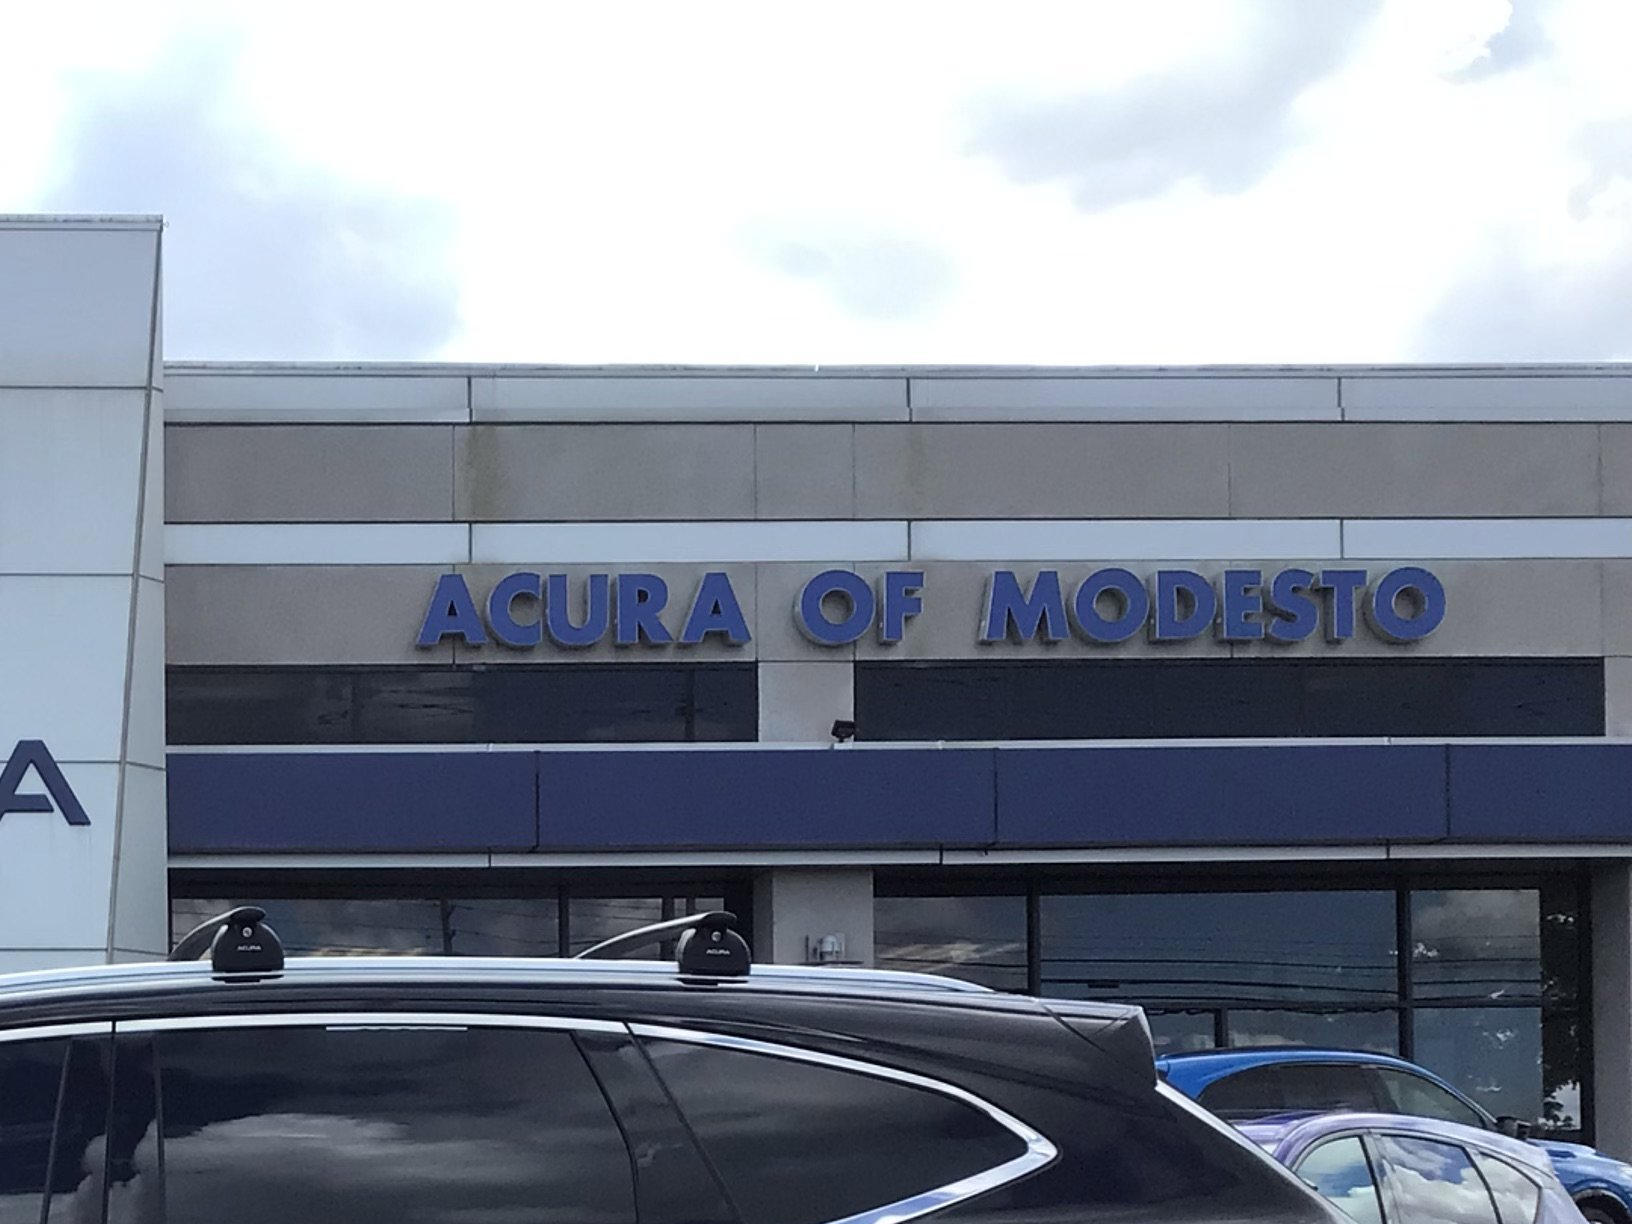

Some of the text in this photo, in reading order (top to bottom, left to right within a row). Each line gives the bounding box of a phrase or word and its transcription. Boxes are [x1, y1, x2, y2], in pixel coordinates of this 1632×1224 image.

[415, 566, 1447, 646] ACURA OF MODESTO
